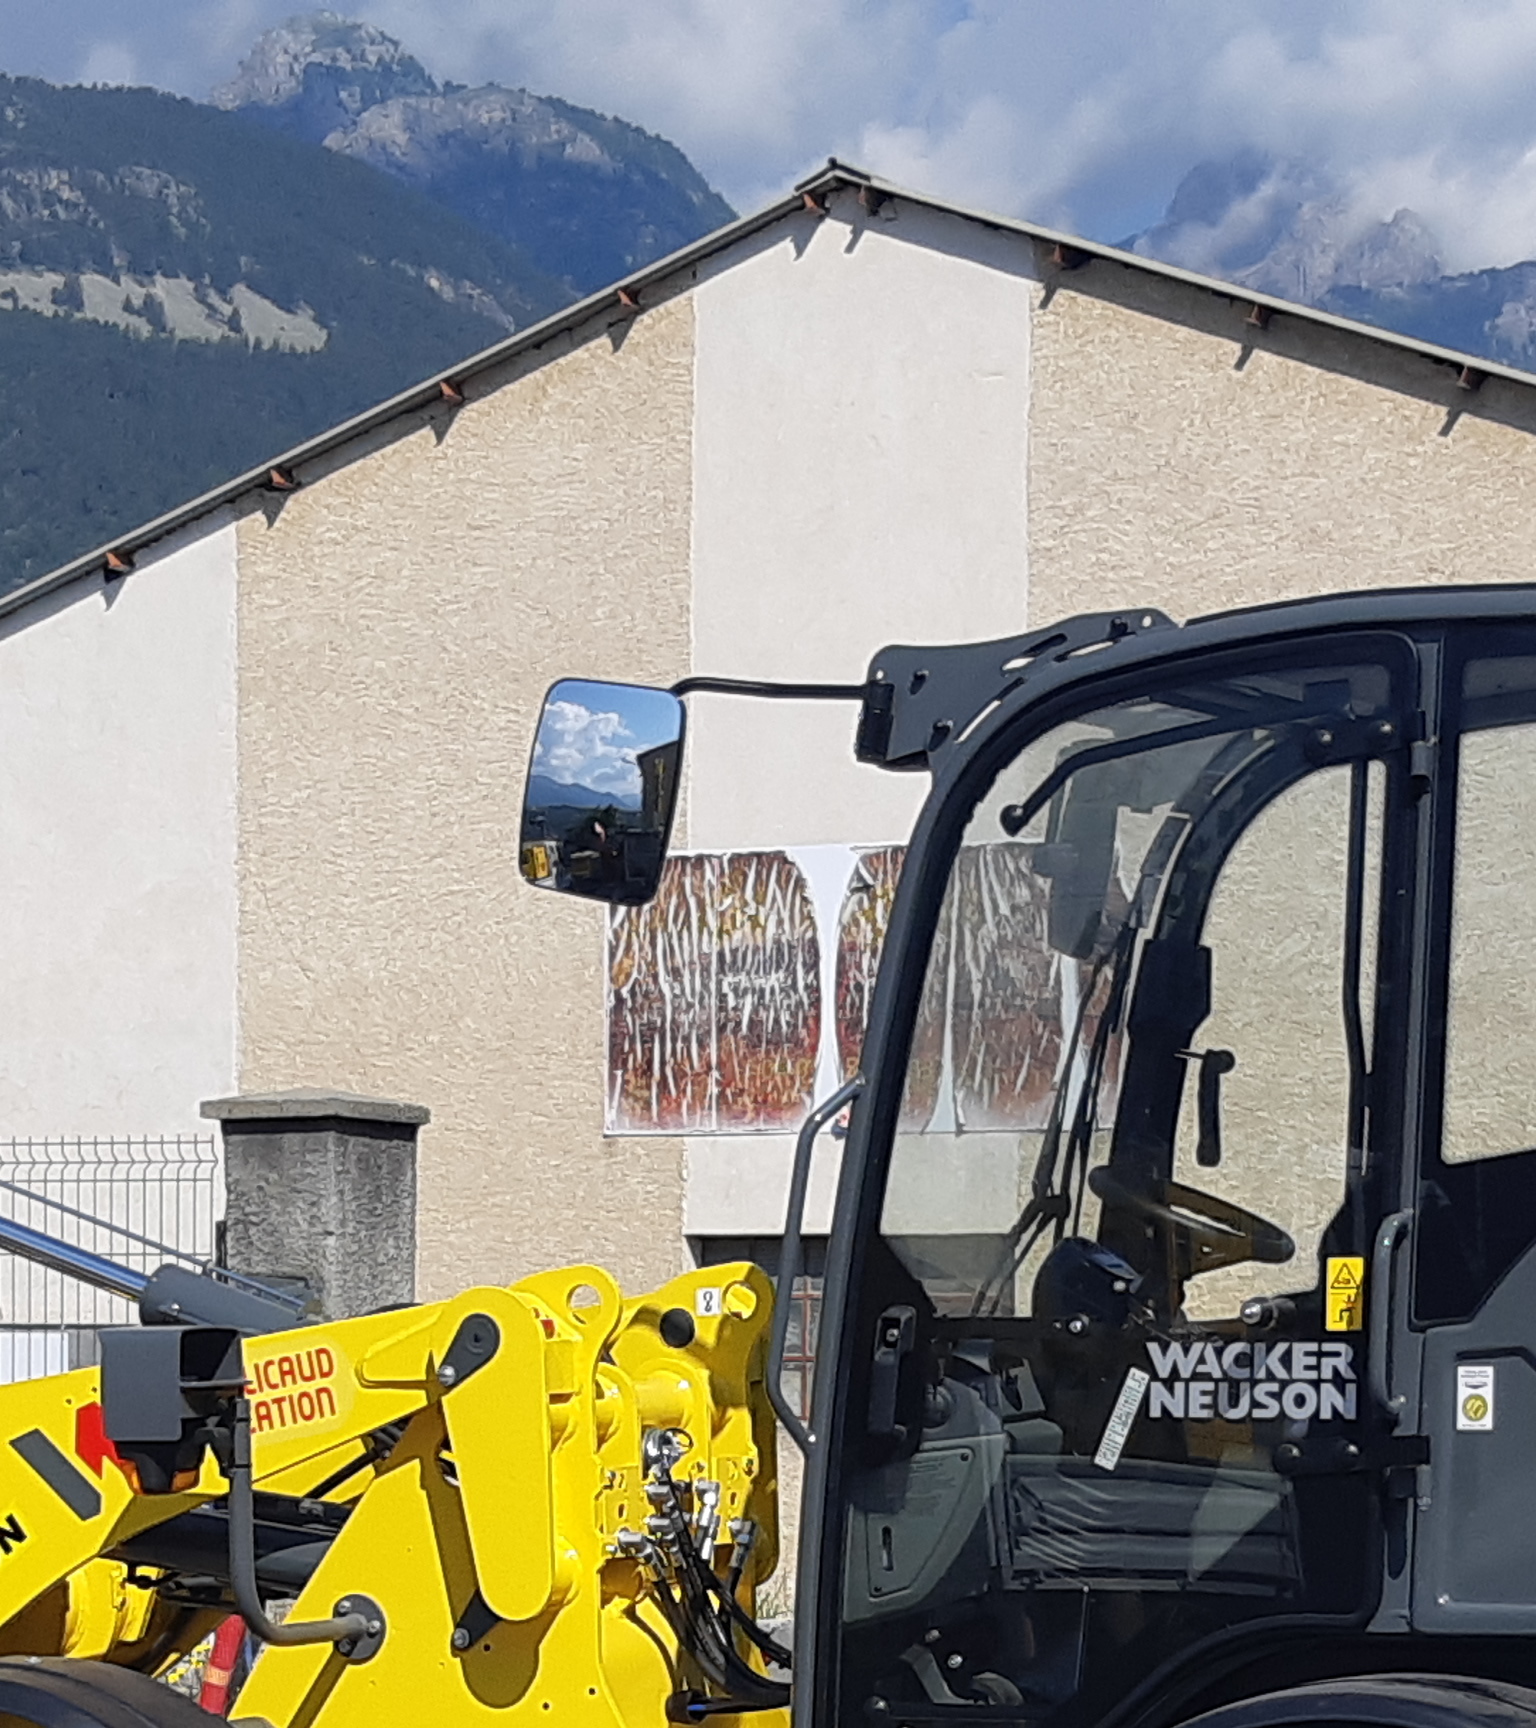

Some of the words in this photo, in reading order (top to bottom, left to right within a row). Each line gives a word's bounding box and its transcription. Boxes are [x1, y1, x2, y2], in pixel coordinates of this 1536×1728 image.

[1145, 1341, 1357, 1380] WACKER
[250, 1387, 336, 1434] ATION
[1148, 1381, 1357, 1420] NEUSON
